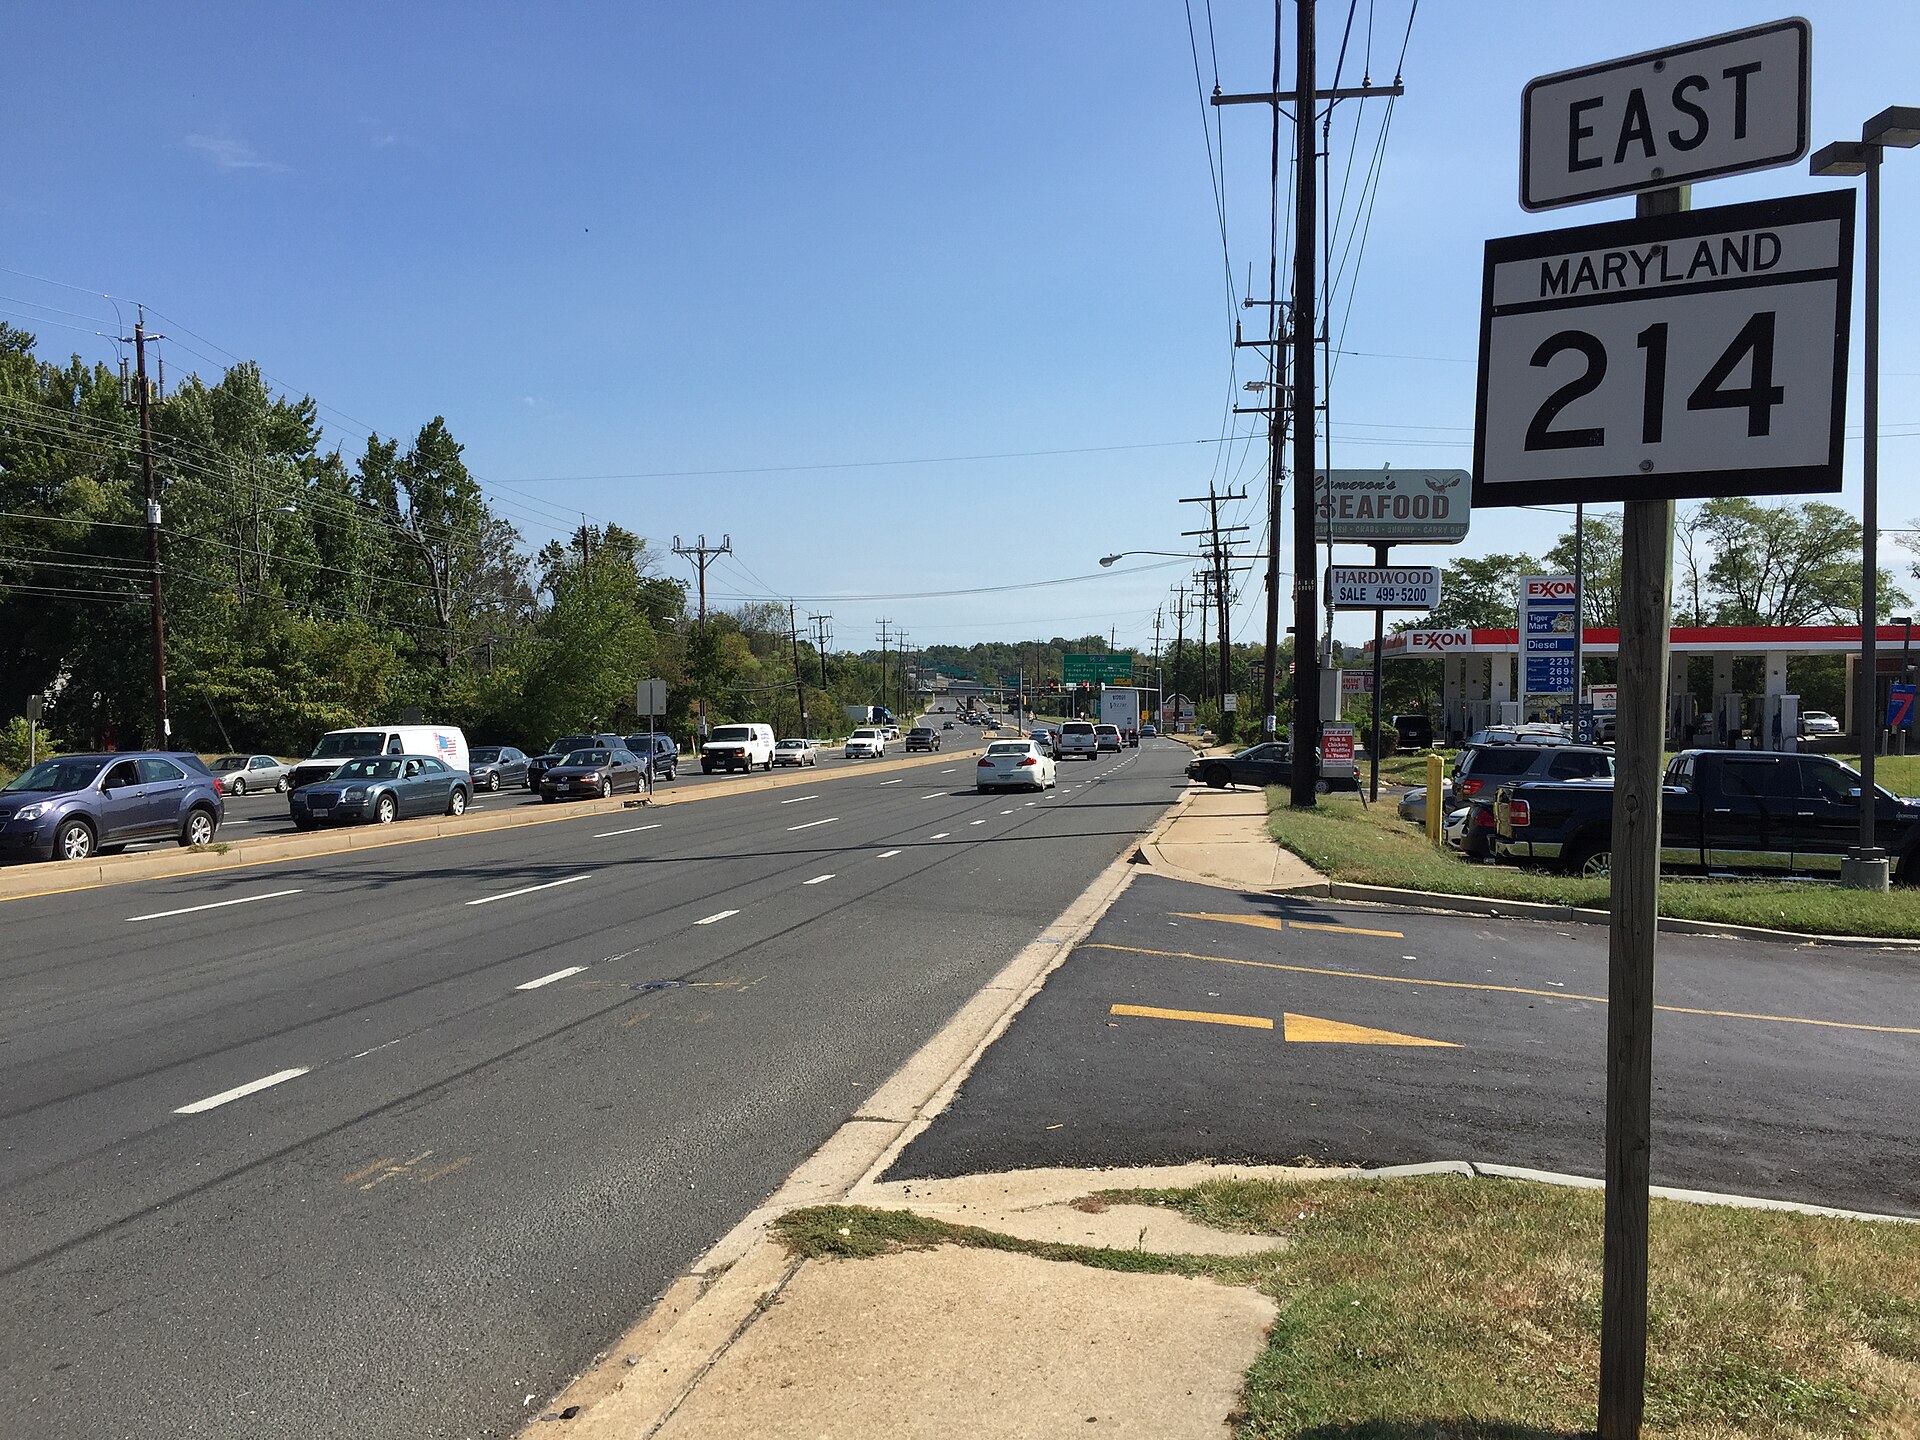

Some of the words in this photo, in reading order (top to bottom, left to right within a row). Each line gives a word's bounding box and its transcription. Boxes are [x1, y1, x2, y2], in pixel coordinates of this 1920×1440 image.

[1568, 61, 1762, 174] EAST
[1540, 232, 1782, 298] MARYLAND
[1524, 311, 1785, 451] 214
[1319, 494, 1450, 520] SEAFOOD
[1355, 526, 1379, 534] CRABS
[1387, 526, 1415, 534] SHRIMP
[1423, 526, 1447, 534] CARRY
[1335, 571, 1434, 585] HARDWOOD
[1339, 587, 1367, 601] SALE
[1376, 587, 1427, 602] 499-5200
[1528, 581, 1576, 599] EXXON
[1529, 614, 1549, 623] Tiger
[1528, 622, 1548, 630] Mart
[1412, 631, 1467, 650] EXXON
[1528, 640, 1558, 649] Diesel
[1549, 658, 1570, 666] 229
[1549, 667, 1570, 676] 269
[1549, 677, 1570, 685] 289
